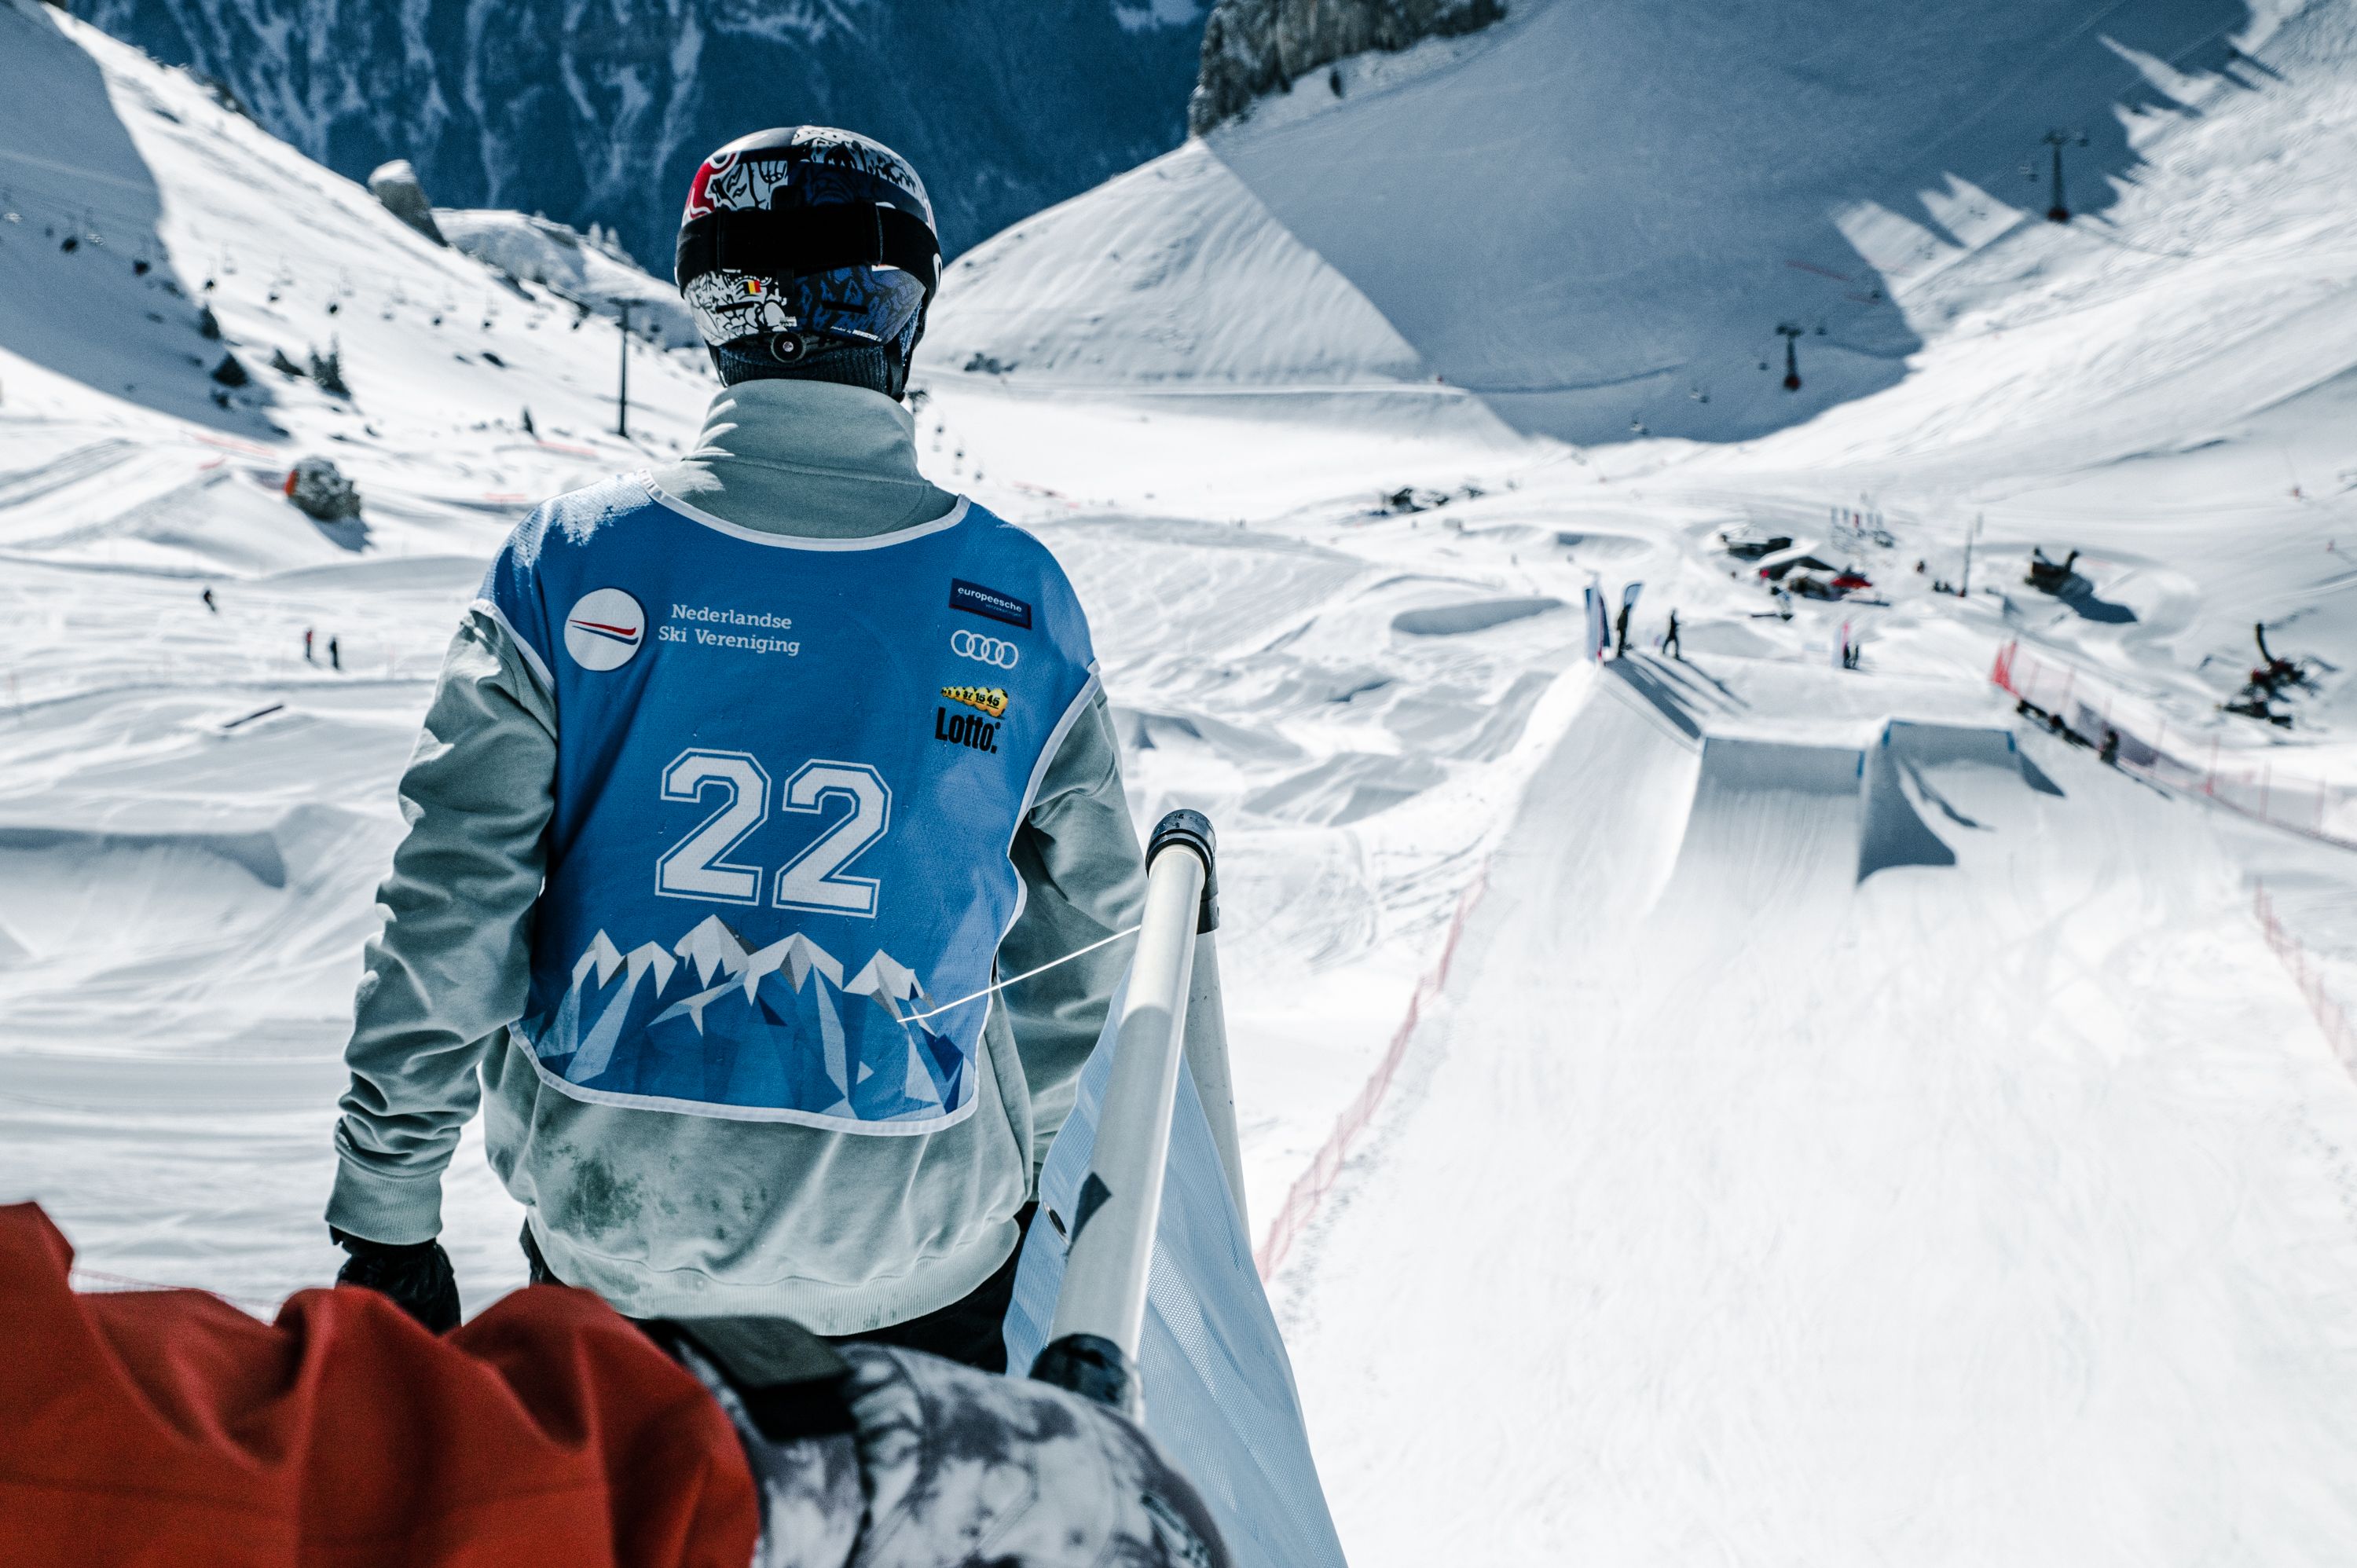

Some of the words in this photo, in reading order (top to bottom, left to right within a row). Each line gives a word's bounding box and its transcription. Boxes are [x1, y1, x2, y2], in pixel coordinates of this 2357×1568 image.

[957, 587, 1023, 613] europeesche
[671, 603, 792, 629] Nederlandse
[658, 626, 687, 643] Ski
[695, 628, 800, 657] Vereniging
[975, 693, 985, 702] 15
[987, 694, 1000, 706] 45
[654, 747, 893, 918] 22
